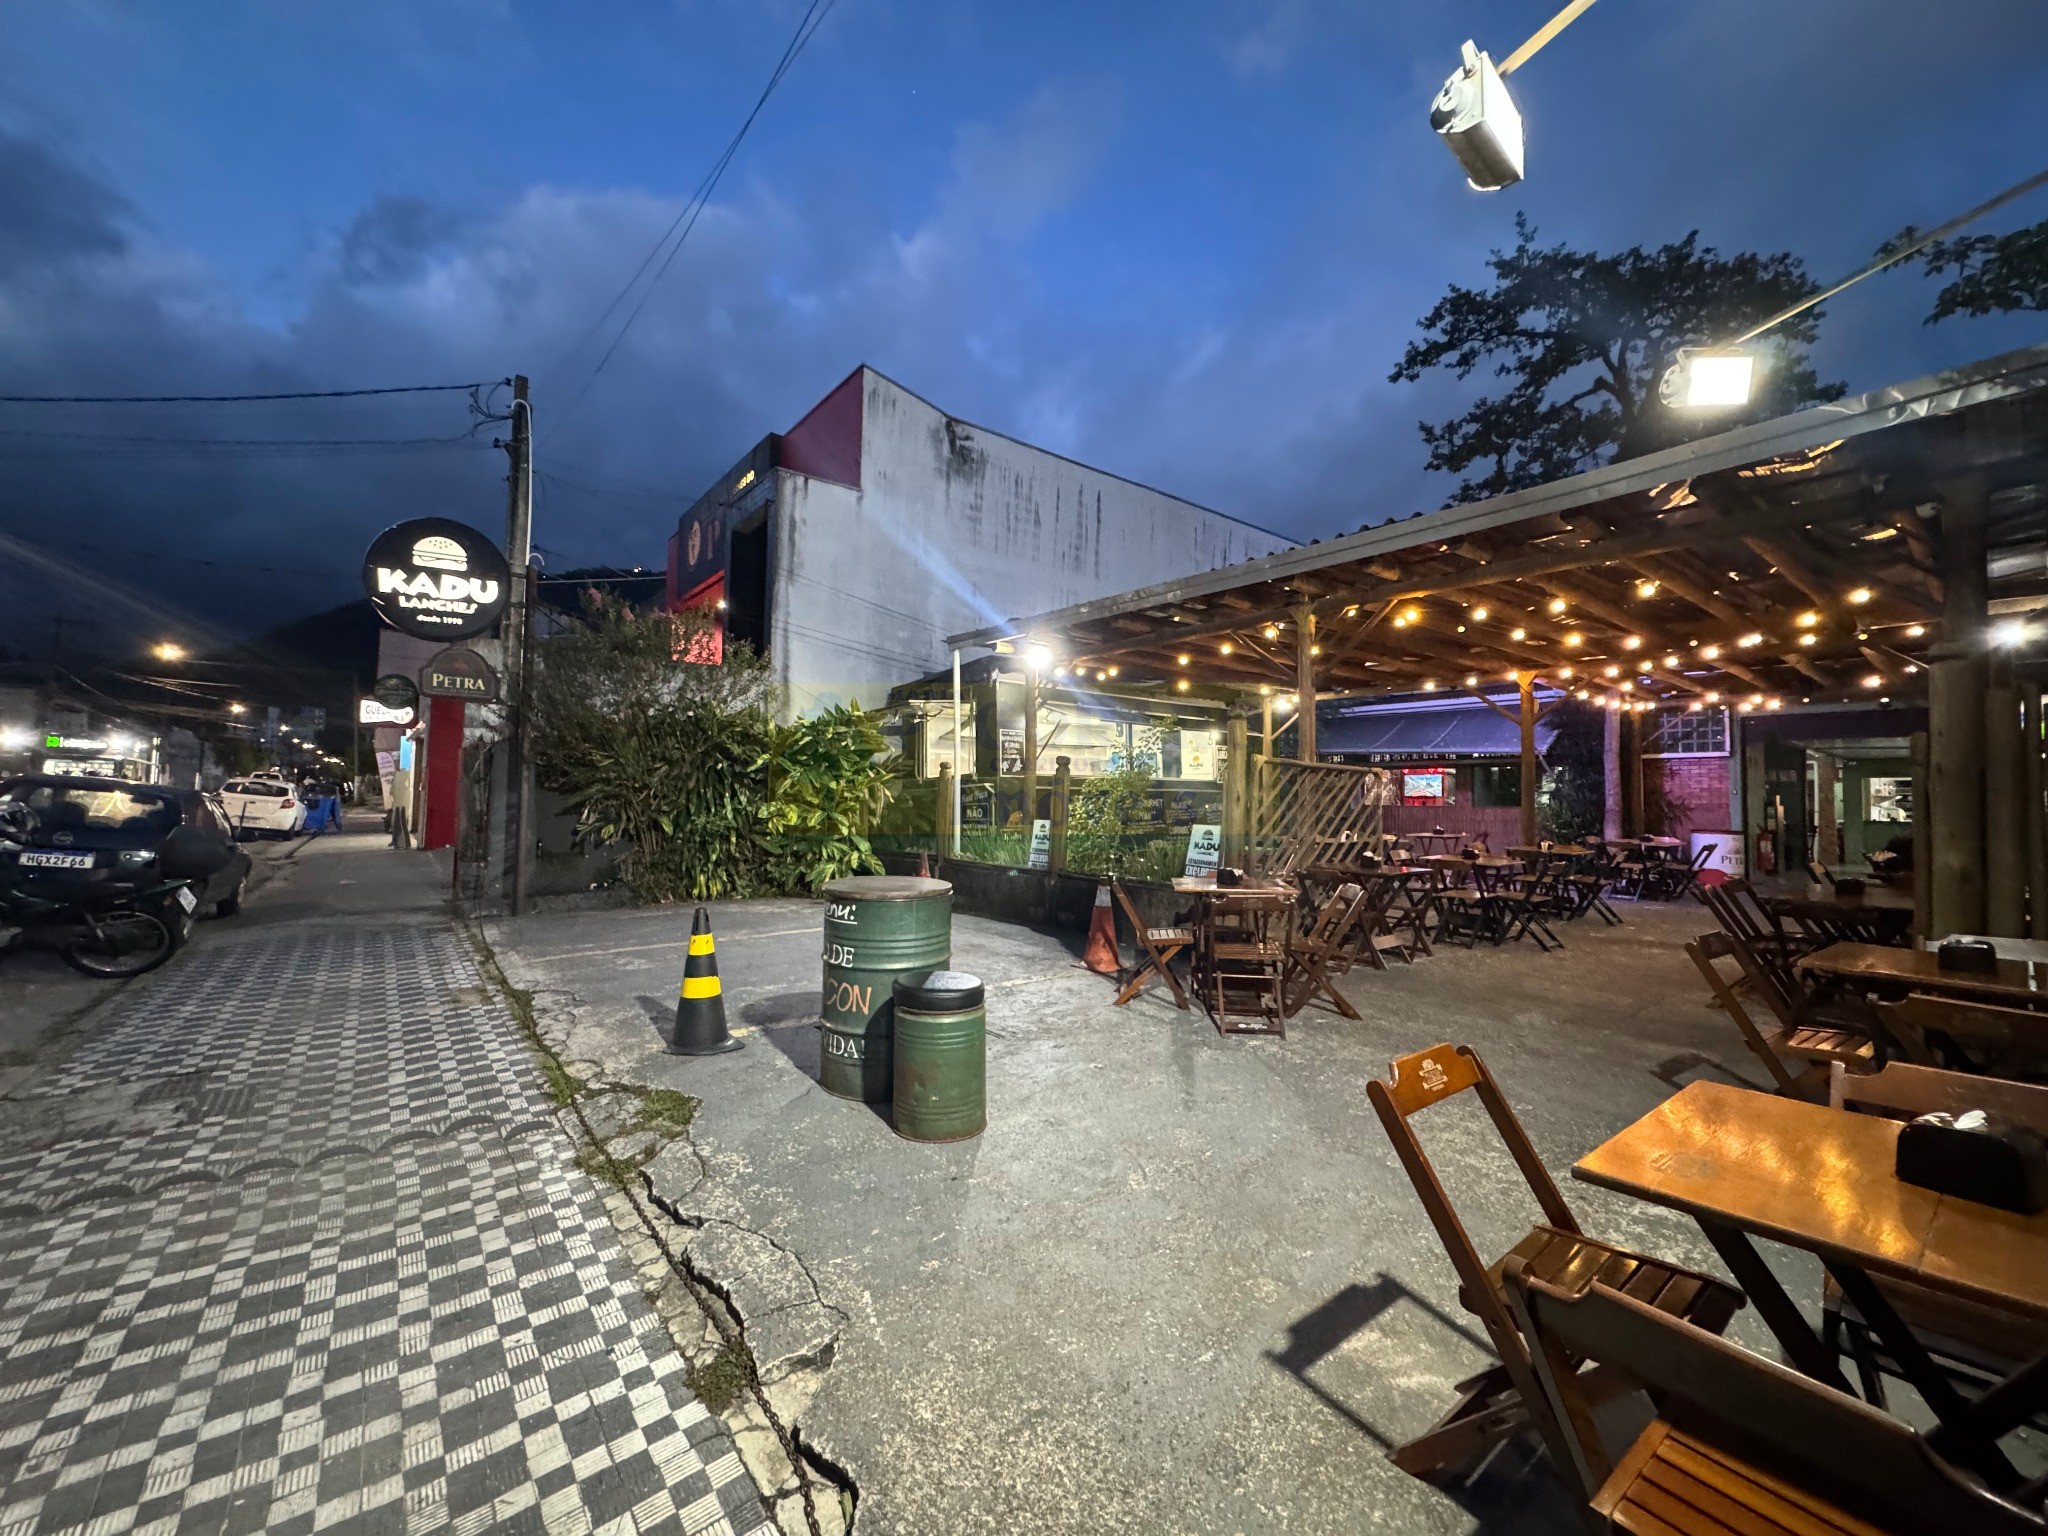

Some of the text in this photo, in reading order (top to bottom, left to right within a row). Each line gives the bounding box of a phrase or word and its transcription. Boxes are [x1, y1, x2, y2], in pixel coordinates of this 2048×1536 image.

[377, 567, 499, 604] KADU
[398, 596, 478, 615] LANCHES
[432, 673, 485, 691] PETRA
[966, 806, 983, 818] NÃO
[1194, 841, 1220, 851] KADU
[26, 854, 86, 867] HGX2F66
[825, 903, 857, 921] enu:
